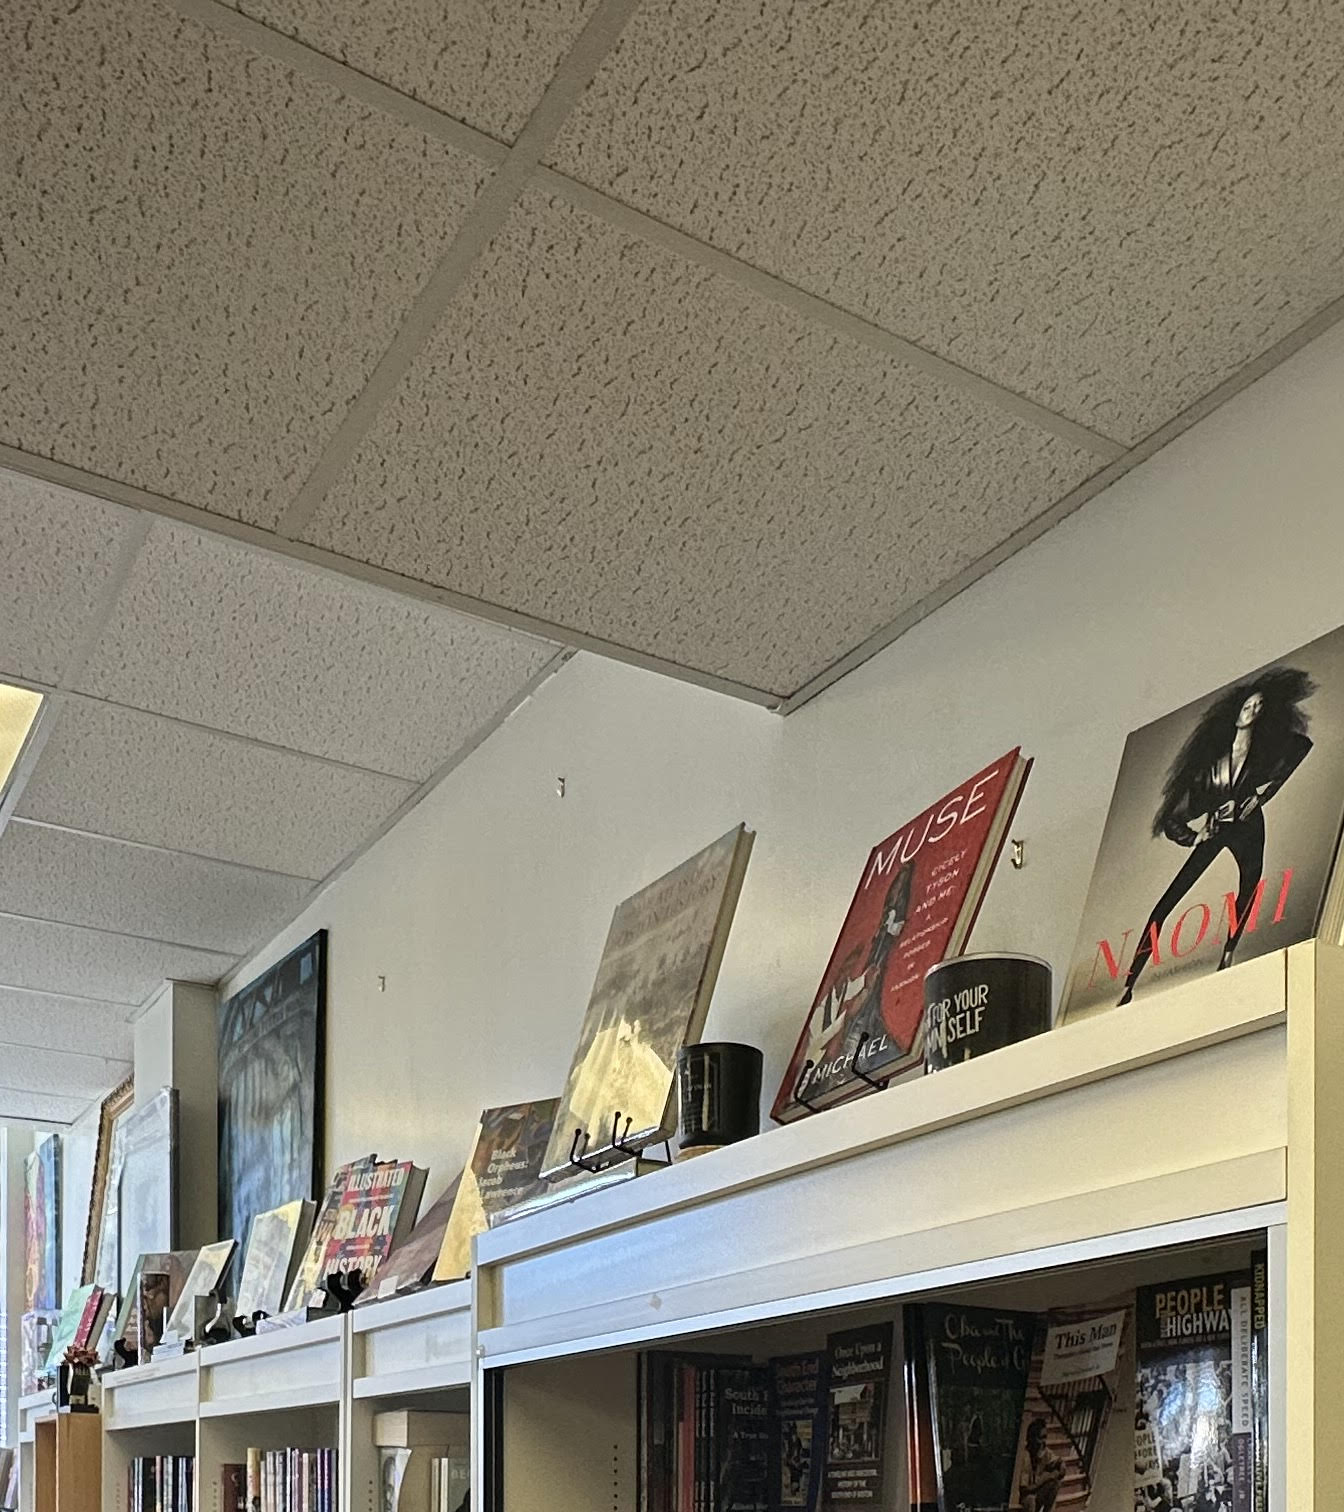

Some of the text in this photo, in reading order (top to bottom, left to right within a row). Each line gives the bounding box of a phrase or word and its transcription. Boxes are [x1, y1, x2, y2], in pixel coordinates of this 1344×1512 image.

[864, 768, 1000, 890] MUSE
[930, 849, 967, 877] CICELY
[926, 868, 961, 894] TYSON
[1087, 867, 1294, 991] NAOMI
[953, 983, 989, 1015] YOUR
[948, 1008, 986, 1044] SELF
[814, 1034, 889, 1086] MICHAEL
[491, 1149, 517, 1159] Black
[347, 1169, 405, 1192] ILLUSTRATED
[333, 1205, 395, 1239] BLACK
[325, 1254, 383, 1282] HISTORY
[1155, 1284, 1225, 1319] PEOPLE
[1253, 1262, 1265, 1329] KIDNAPPED
[1056, 1322, 1117, 1349] This Man
[1238, 1318, 1250, 1428] DELIBERATE SPEED
